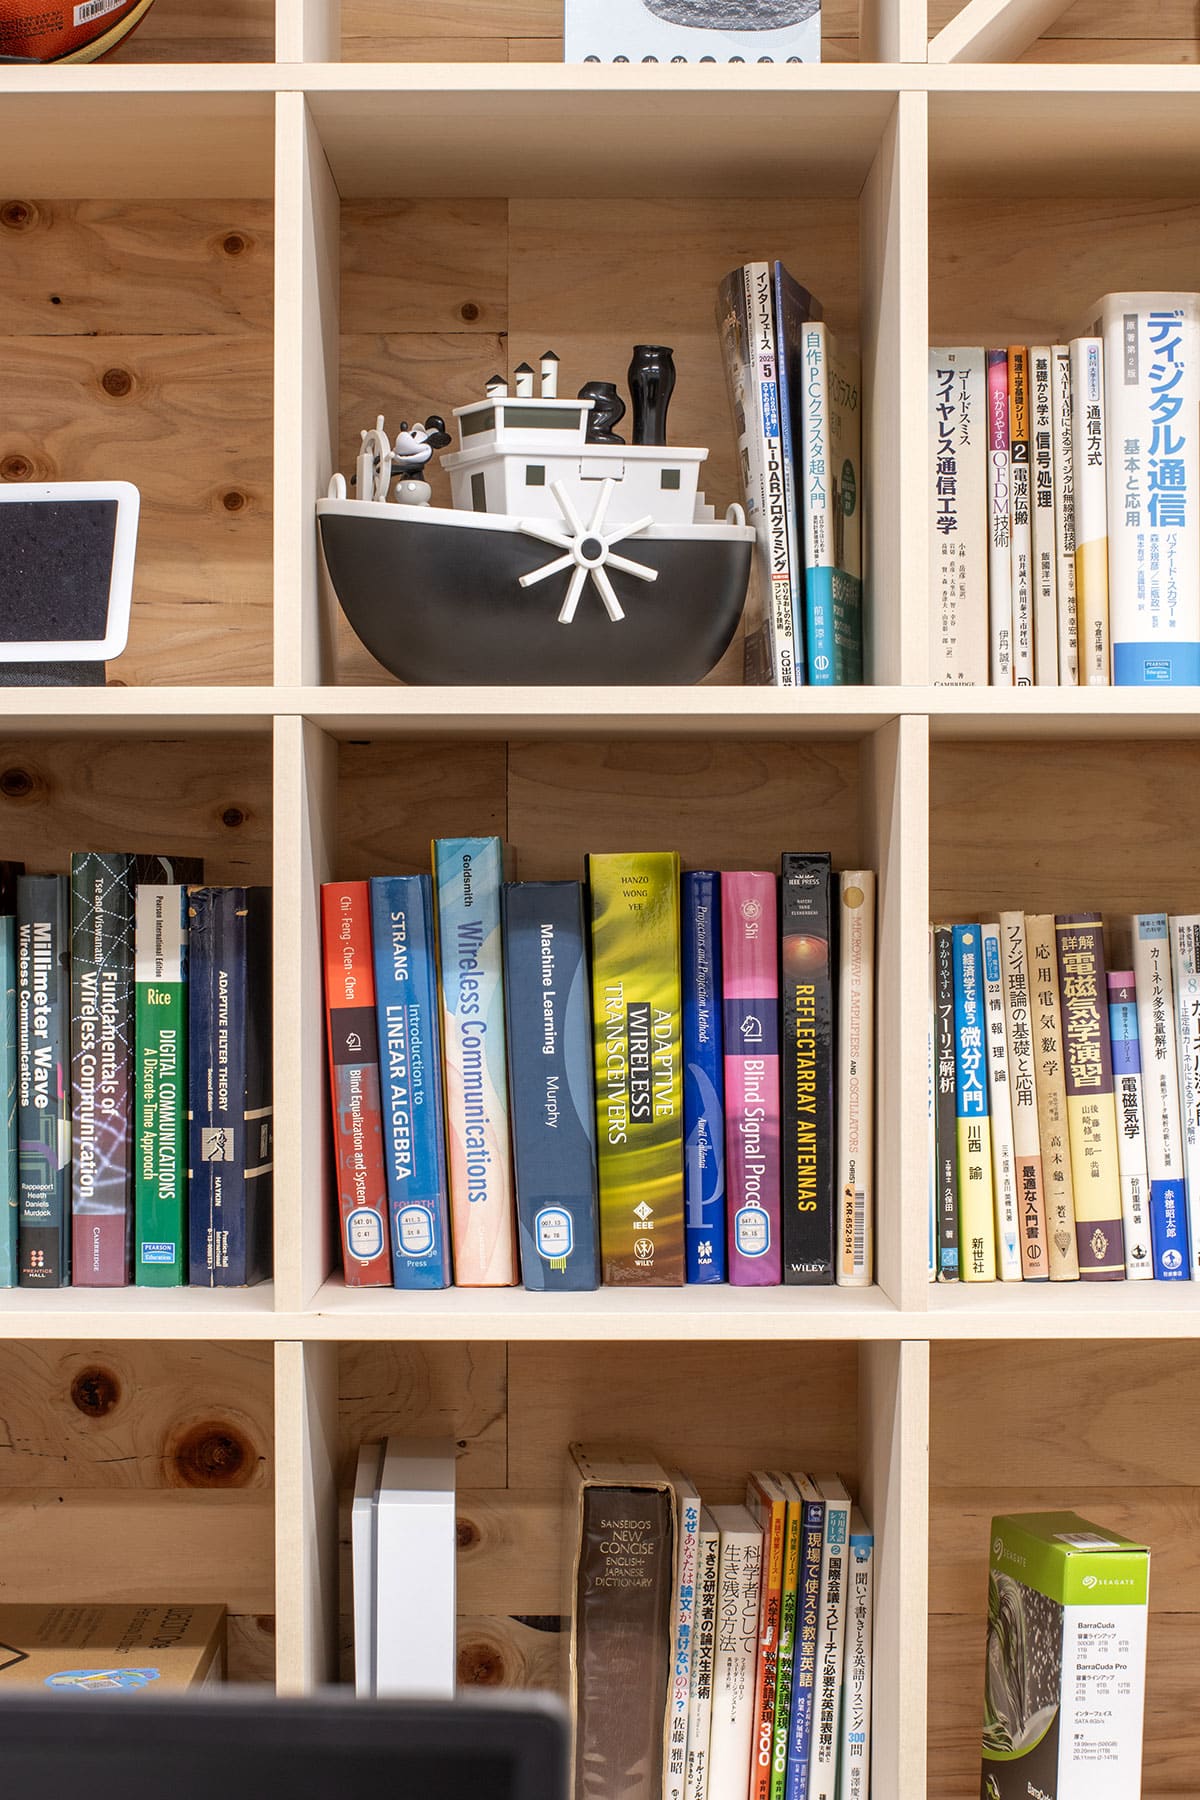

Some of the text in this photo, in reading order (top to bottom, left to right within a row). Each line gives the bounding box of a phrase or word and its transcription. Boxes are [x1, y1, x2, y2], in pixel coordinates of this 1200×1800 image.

[756, 272, 771, 350] インターフェース
[763, 364, 772, 378] 5
[1126, 321, 1136, 378] 原著第2版
[805, 332, 826, 509] 自作PCクラスタ超入門
[958, 369, 971, 446] ゴールドスミス
[1014, 355, 1024, 437] 電波工学基礎シリーズ
[1147, 310, 1187, 528] ディジタル通信
[936, 369, 958, 535] ワイヤレス通信工学
[1014, 444, 1026, 460] 2
[1036, 358, 1052, 508] 基礎から学ぶ 信号処理
[1087, 405, 1103, 466] 通信方式
[767, 438, 787, 572] LiDARプログラミング
[1013, 467, 1028, 525] 電波伝搬
[1124, 438, 1141, 527] 基本と応用
[774, 582, 784, 630] コンピュータ技術
[782, 582, 792, 637] やりなおしのための
[462, 854, 474, 907] Goldsmith
[621, 876, 649, 884] HANZO
[622, 890, 648, 898] WONG
[628, 903, 643, 911] YEE
[801, 878, 820, 886] PRESS
[94, 878, 104, 963] Tse and Viswanath
[155, 896, 163, 978] Pearson International Edition
[339, 895, 357, 1000] Chi Feng Chen Chen
[390, 911, 409, 981] STRANG
[744, 923, 758, 940] Shi
[1061, 935, 1095, 950] 詳解
[147, 988, 172, 1005] Rice
[695, 905, 710, 1044] Projectors and Projection Methods
[988, 985, 1000, 993] 22
[1119, 988, 1128, 999] 4
[1150, 947, 1168, 1060] カーネル多変量解析
[1187, 978, 1198, 993] 8
[19, 924, 31, 1107] Wireless Communications
[33, 922, 52, 1109] Millimeter Wave
[540, 923, 560, 1129] Machine Learning Murphy
[938, 939, 956, 1093] わかりやすい フーリエ解析
[1007, 926, 1033, 1107] ファジィ理論の基礎と応用
[1035, 943, 1058, 1076] 応用電気数学
[1062, 951, 1102, 1088] 電磁気学演習
[101, 972, 119, 1116] Fundamentals of
[218, 970, 228, 1112] ADAPTIVE FILTER THEORY
[409, 1004, 425, 1105] Introduction to
[457, 920, 492, 1204] Wireless Communications
[604, 982, 627, 1145] TRANSCEIVERS
[628, 1007, 650, 1118] WIRELESS
[653, 1009, 674, 1117] ADAPTIVE
[848, 916, 863, 1184] MICROWAVE AMPLIFIERS AND OSCILLATORS CHRIST
[989, 999, 1007, 1083] 情報理論
[80, 972, 98, 1198] Wireless Communication
[349, 1070, 361, 1094] Blind
[385, 1005, 412, 1181] LINEAR ALGEBRA
[744, 1060, 765, 1103] Blind
[795, 984, 818, 1212] REFLECTARRAY ANTENNAS
[1121, 1077, 1140, 1139] 電磁気学
[140, 1048, 159, 1180] A Discrete-Time Approach
[158, 1029, 177, 1199] DIGITAL COMMUNICATIONS
[349, 1096, 365, 1151] Equalization
[739, 1107, 766, 1159] Signal
[21, 1183, 54, 1192] Rappaport
[214, 1176, 222, 1207] HAYKIN
[354, 1152, 366, 1169] and
[355, 1170, 367, 1205] System
[24, 1209, 51, 1217] Murdock
[632, 1221, 654, 1230] IEEE
[1022, 1165, 1039, 1239] 最適な入門書
[1164, 1189, 1177, 1238] 赤穂昭太郎
[93, 1227, 101, 1272] CAMBRIDGE
[634, 1259, 654, 1267] WILEY
[791, 1263, 825, 1272] WILEY
[971, 1237, 985, 1274] 新世社
[599, 1542, 655, 1555] CONCISE
[600, 1519, 652, 1530] SANSEIDO'S
[612, 1530, 643, 1542] NEW
[828, 1512, 837, 1543] シリーズ
[836, 1512, 846, 1543] 実用英語
[595, 1577, 653, 1588] DICTIONARY
[604, 1567, 645, 1577] JAPANESE
[605, 1556, 646, 1566] ENGLISH-
[697, 1540, 718, 1700] できる研究者の論文生産術
[719, 1544, 741, 1653] 生き残る方法
[739, 1545, 761, 1654] 科学者として
[767, 1597, 778, 1628] 大学生
[783, 1592, 796, 1633] 大学教員
[799, 1532, 822, 1688] 現場で使える教室英語
[819, 1557, 842, 1746] 国際会議・スピーチに必要な英語表現
[848, 1572, 868, 1757] 聞いて書きとる英語リスニング300問
